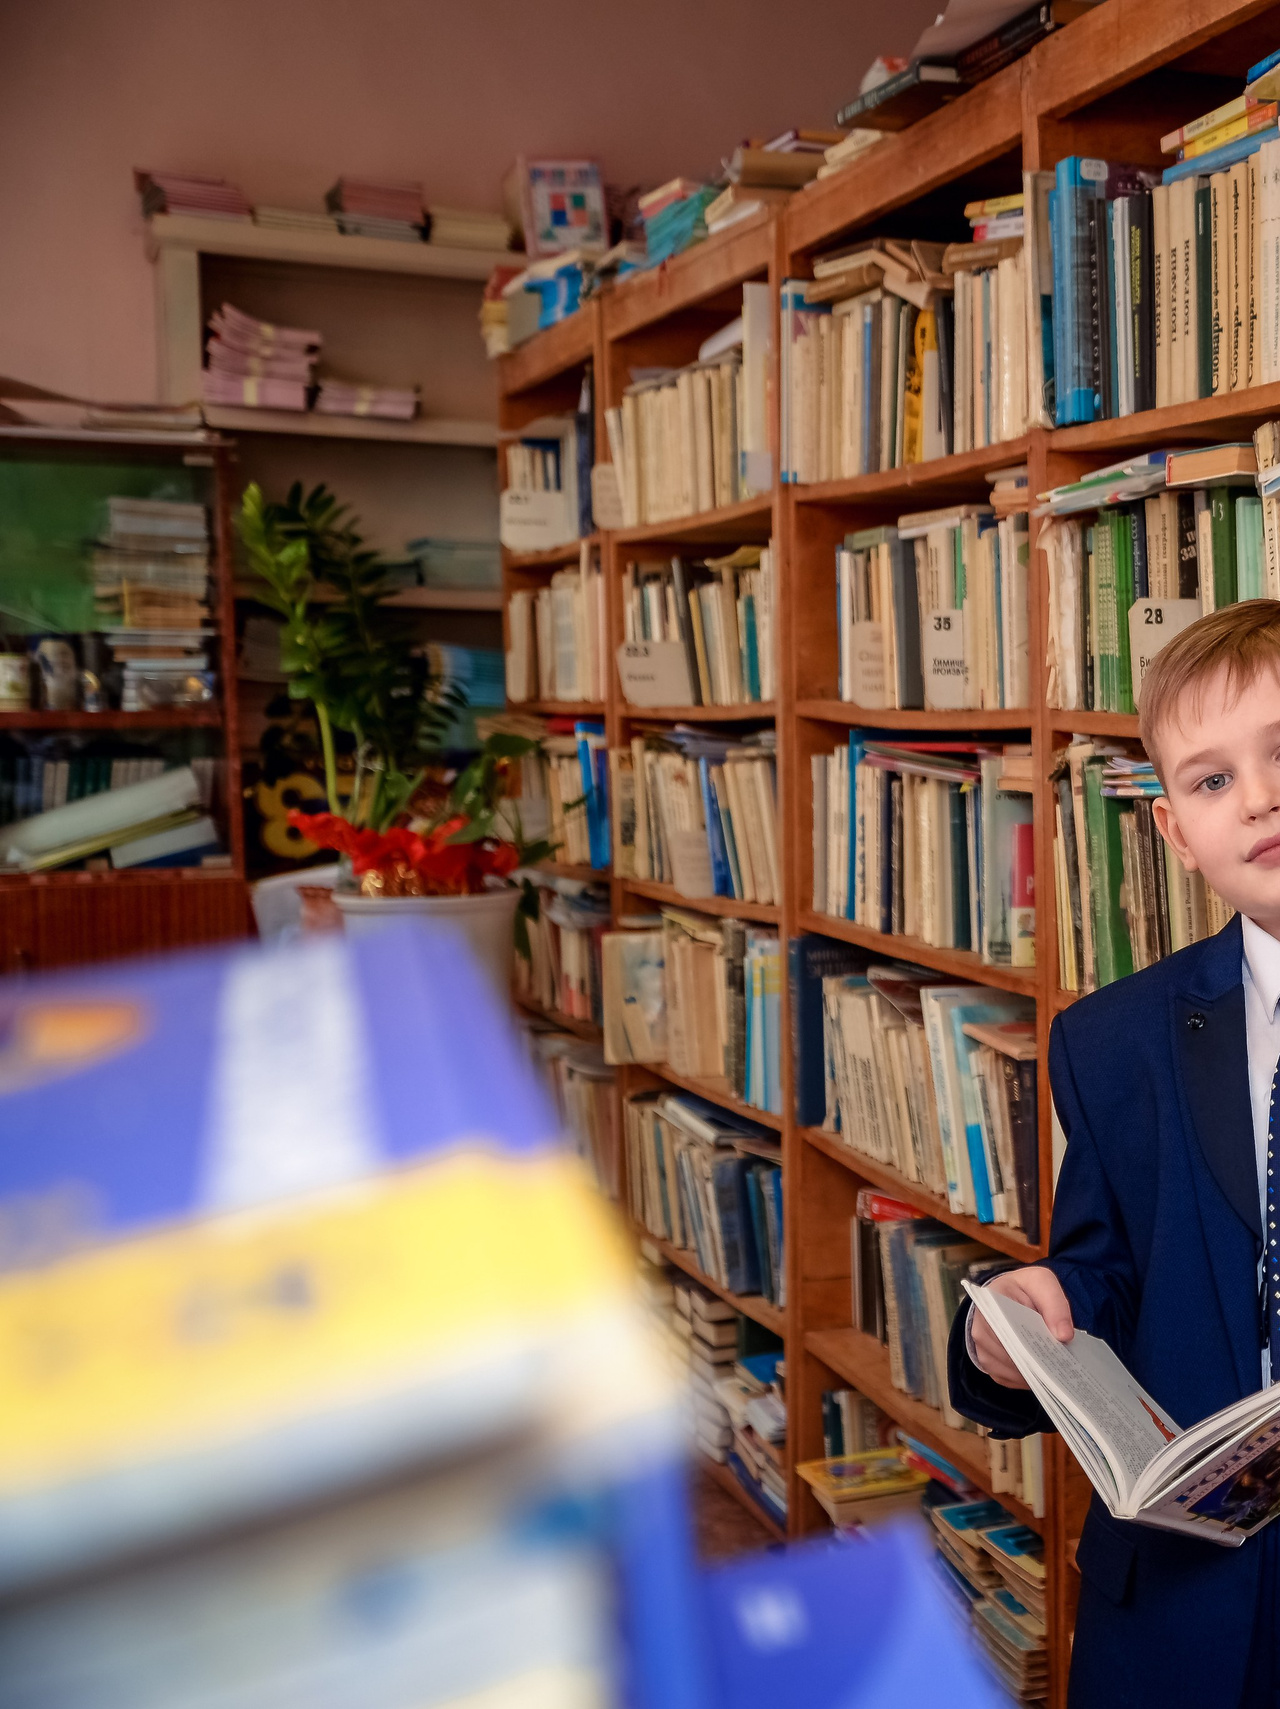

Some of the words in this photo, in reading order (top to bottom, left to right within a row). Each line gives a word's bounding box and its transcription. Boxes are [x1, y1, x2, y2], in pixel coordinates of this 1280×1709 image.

[1212, 240, 1220, 297] физической
[1212, 311, 1224, 393] Словарь
[1231, 305, 1242, 389] Словарь
[1133, 541, 1141, 582] география
[933, 617, 952, 631] 35
[1144, 608, 1164, 625] 28
